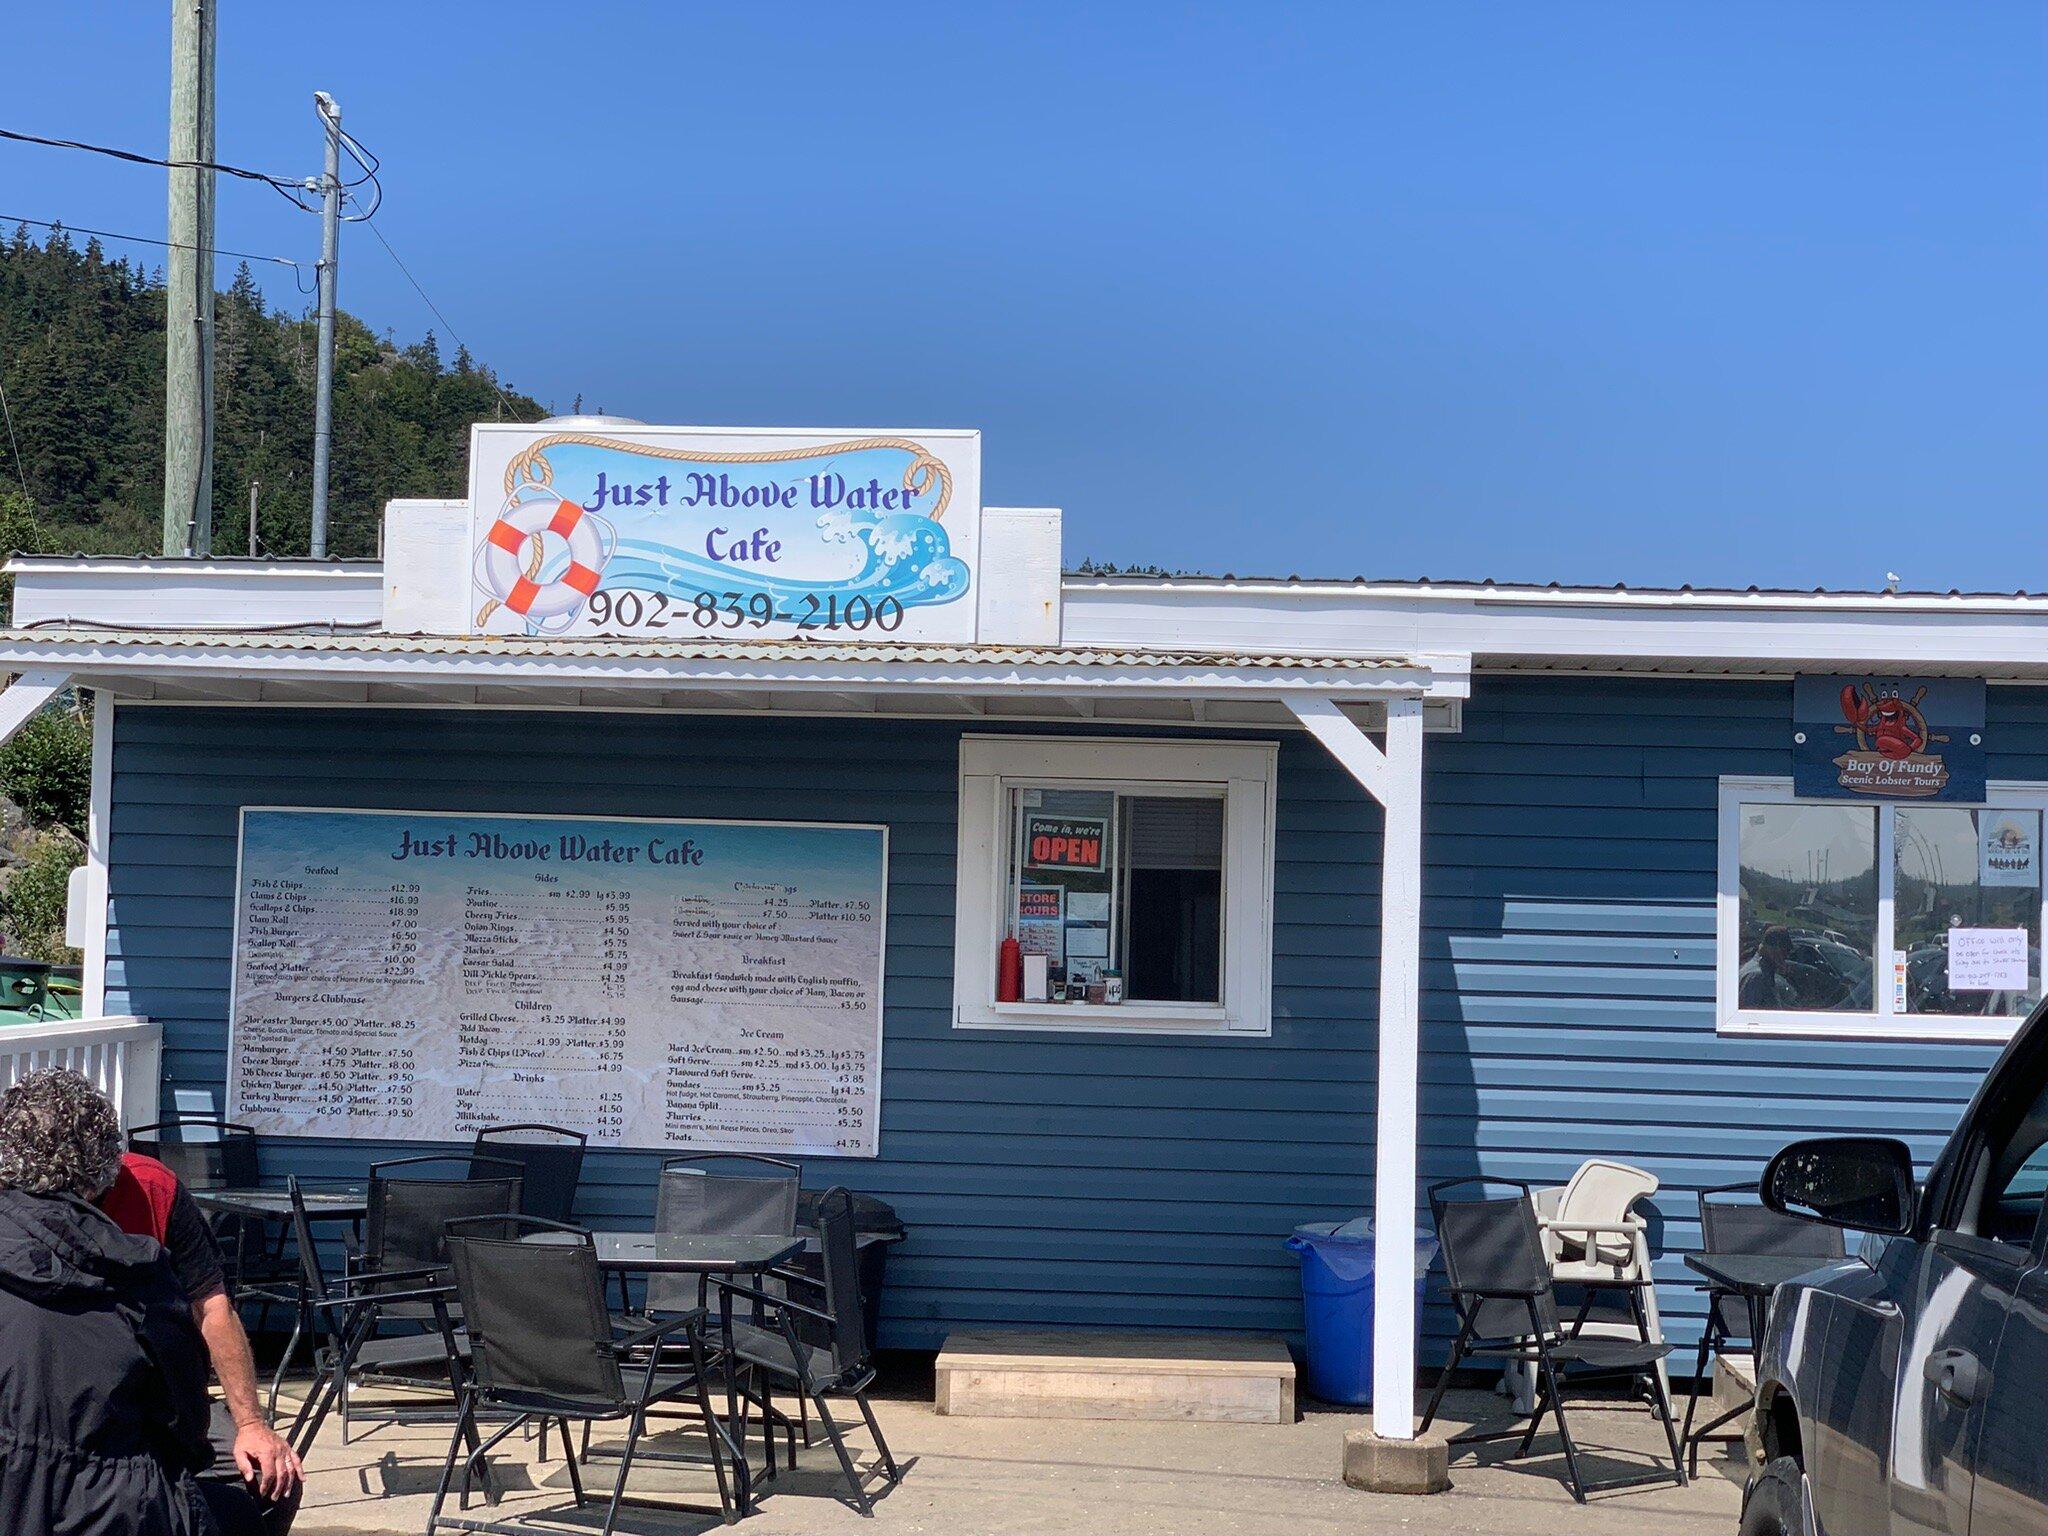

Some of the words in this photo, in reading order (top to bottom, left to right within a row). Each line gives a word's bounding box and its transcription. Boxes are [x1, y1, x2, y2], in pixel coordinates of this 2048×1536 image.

[583, 472, 672, 512] Just
[680, 474, 797, 508] Above
[807, 475, 920, 510] Water
[706, 528, 782, 563] Cafe
[588, 591, 904, 631] 902-839-2100
[1847, 761, 1875, 774] Bay
[1879, 761, 1894, 775] Of
[1899, 761, 1942, 775] Fundy
[1842, 775, 1873, 784] Scenic
[1875, 776, 1911, 785] Lobster
[1915, 777, 1940, 786] Tours
[1033, 823, 1058, 833] Come
[1061, 825, 1072, 834] in,
[1076, 827, 1100, 836] we're
[392, 831, 457, 861] Just
[464, 833, 551, 861] Above
[559, 834, 640, 863] Water
[648, 837, 704, 866] Cafe
[1033, 837, 1098, 863] OPEN
[305, 866, 338, 875] Seafood
[535, 873, 558, 882] Sides
[252, 880, 271, 888] Fish
[280, 880, 303, 890] Chips
[392, 884, 420, 892] $12.99
[251, 891, 275, 900] Clams
[285, 892, 306, 901] Chips
[466, 887, 489, 895] Fries
[566, 890, 590, 898] $2.99
[597, 891, 604, 901] lg
[606, 891, 630, 899] $3.99
[250, 903, 282, 913] Scallops
[292, 905, 315, 914] Chips
[466, 899, 497, 908] Poutine
[606, 903, 629, 911] $5.95
[249, 915, 269, 924] Clam
[272, 915, 288, 924] Roll
[392, 920, 417, 928] $7.00
[465, 911, 492, 920] Cheesy
[495, 911, 518, 919] Fries
[605, 915, 629, 923] $5.95
[249, 927, 268, 935] Fish
[270, 928, 299, 937] Burger
[392, 932, 416, 940] $6.50
[465, 923, 488, 931] Onion
[491, 924, 514, 933] Rings
[464, 934, 491, 943] Mozza
[493, 935, 518, 944] Sticks
[604, 939, 627, 947] $5.75
[604, 951, 627, 959] $5.75
[742, 955, 785, 965] Breakfast
[247, 963, 277, 971] Seafood
[280, 964, 310, 972] Platter
[463, 958, 490, 966] Caesar
[492, 959, 514, 967] Salad
[463, 970, 478, 978] Dill
[481, 970, 506, 979] Pickle
[509, 972, 536, 980] Spears
[602, 974, 625, 982] $4.25
[672, 970, 712, 981] Breakfast
[714, 972, 753, 982] Sandwich
[756, 974, 775, 982] made
[778, 974, 795, 984] with
[798, 975, 828, 986] English
[830, 976, 860, 987] muffin,
[671, 984, 683, 992] egg
[686, 983, 700, 992] and
[702, 984, 727, 993] cheese
[729, 985, 747, 994] with
[749, 986, 768, 995] your
[770, 986, 793, 995] choice
[805, 987, 827, 997] Ham,
[830, 988, 853, 997] Bacon
[275, 993, 310, 1003] Burgers
[321, 994, 366, 1005] Clubhouse
[671, 995, 703, 1005] Sausage
[841, 1001, 866, 1010] $3.50
[515, 1001, 552, 1011] Children
[290, 1016, 319, 1027] Burger
[322, 1018, 348, 1026] $5.00
[354, 1019, 384, 1028] Platter
[391, 1021, 415, 1029] $8.25
[460, 1013, 487, 1022] Grilled
[490, 1013, 516, 1022] Cheese
[568, 1016, 597, 1025] Platter
[740, 1029, 754, 1038] Ice
[756, 1029, 784, 1039] Cream
[459, 1036, 488, 1045] Hotdog
[537, 1038, 560, 1046] $1.99
[565, 1039, 596, 1047] Platter
[599, 1040, 623, 1048] $3.99
[242, 1044, 289, 1055] Hamburger
[322, 1047, 347, 1055] $4.50
[351, 1048, 381, 1057] Platter
[388, 1050, 412, 1058] $7.50
[242, 1056, 268, 1065] Cheese
[271, 1057, 300, 1067] Burger
[322, 1059, 346, 1067] $4.75
[351, 1060, 382, 1069] Platter
[389, 1062, 414, 1070] $8.00
[513, 1073, 545, 1083] Drinks
[668, 1068, 709, 1077] Flavoured
[712, 1069, 728, 1078] Soft
[731, 1071, 753, 1079] Serve
[839, 1075, 864, 1083] $3.85
[241, 1080, 271, 1090] Chicken
[274, 1082, 303, 1091] Burger
[318, 1083, 343, 1091] $4.50
[348, 1084, 377, 1092] Platter
[388, 1085, 412, 1093] $7.50
[667, 1080, 700, 1089] Sundaes
[756, 1084, 779, 1092] $3.25
[831, 1086, 839, 1096] lg
[841, 1087, 865, 1096] $4.25
[457, 1088, 481, 1097] Water
[600, 1093, 622, 1101] $1.25
[240, 1104, 281, 1114] Clubhouse
[316, 1107, 341, 1115] $6.50
[347, 1108, 377, 1116] Platter
[388, 1109, 413, 1118] $9.50
[456, 1100, 473, 1109] Pop
[599, 1105, 622, 1113] $1.50
[666, 1100, 696, 1109] Banana
[699, 1101, 718, 1111] Split
[838, 1107, 863, 1116] $5.50
[456, 1112, 500, 1122] Milkshake
[597, 1117, 622, 1125] $4.50
[666, 1112, 701, 1121] Flurries
[838, 1119, 862, 1127] $5.25
[666, 1132, 691, 1141] Floats
[836, 1139, 860, 1148] $4.75
